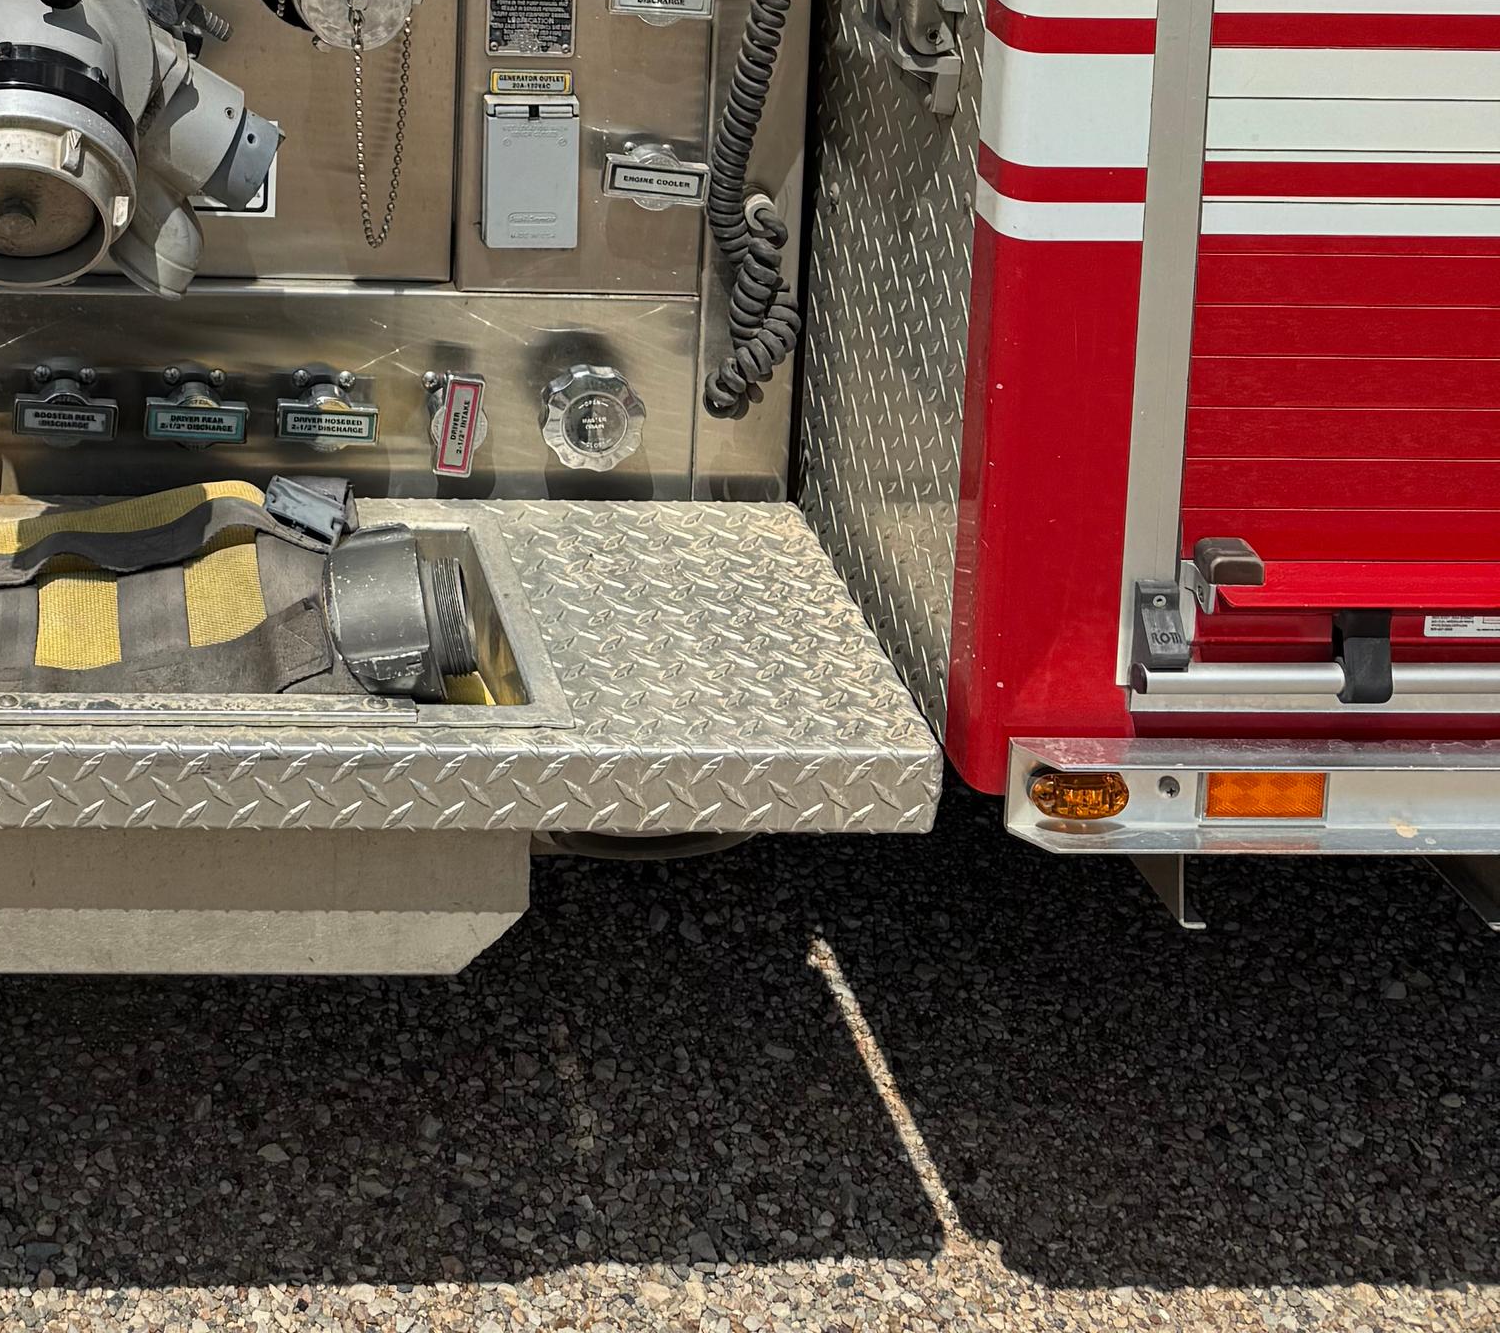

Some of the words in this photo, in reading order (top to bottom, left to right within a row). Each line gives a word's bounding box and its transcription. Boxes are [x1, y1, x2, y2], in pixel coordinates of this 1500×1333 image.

[498, 74, 538, 83] GENERATOR
[539, 75, 565, 83] OUTLET
[624, 175, 654, 186] ENGINE
[656, 178, 691, 189] COOLER
[34, 412, 68, 421] BOOSTER
[71, 414, 97, 422] REEL
[460, 399, 471, 428] INTAKE
[39, 420, 90, 429] DISCHARGE
[170, 415, 200, 423] DRIVER
[201, 416, 224, 424] REAR
[293, 416, 322, 424] DRIVER
[324, 418, 363, 426] HOSEBED
[186, 423, 234, 433] DISCHARGE
[317, 425, 364, 434] DISCHARGE
[451, 411, 460, 441] DRIVER
